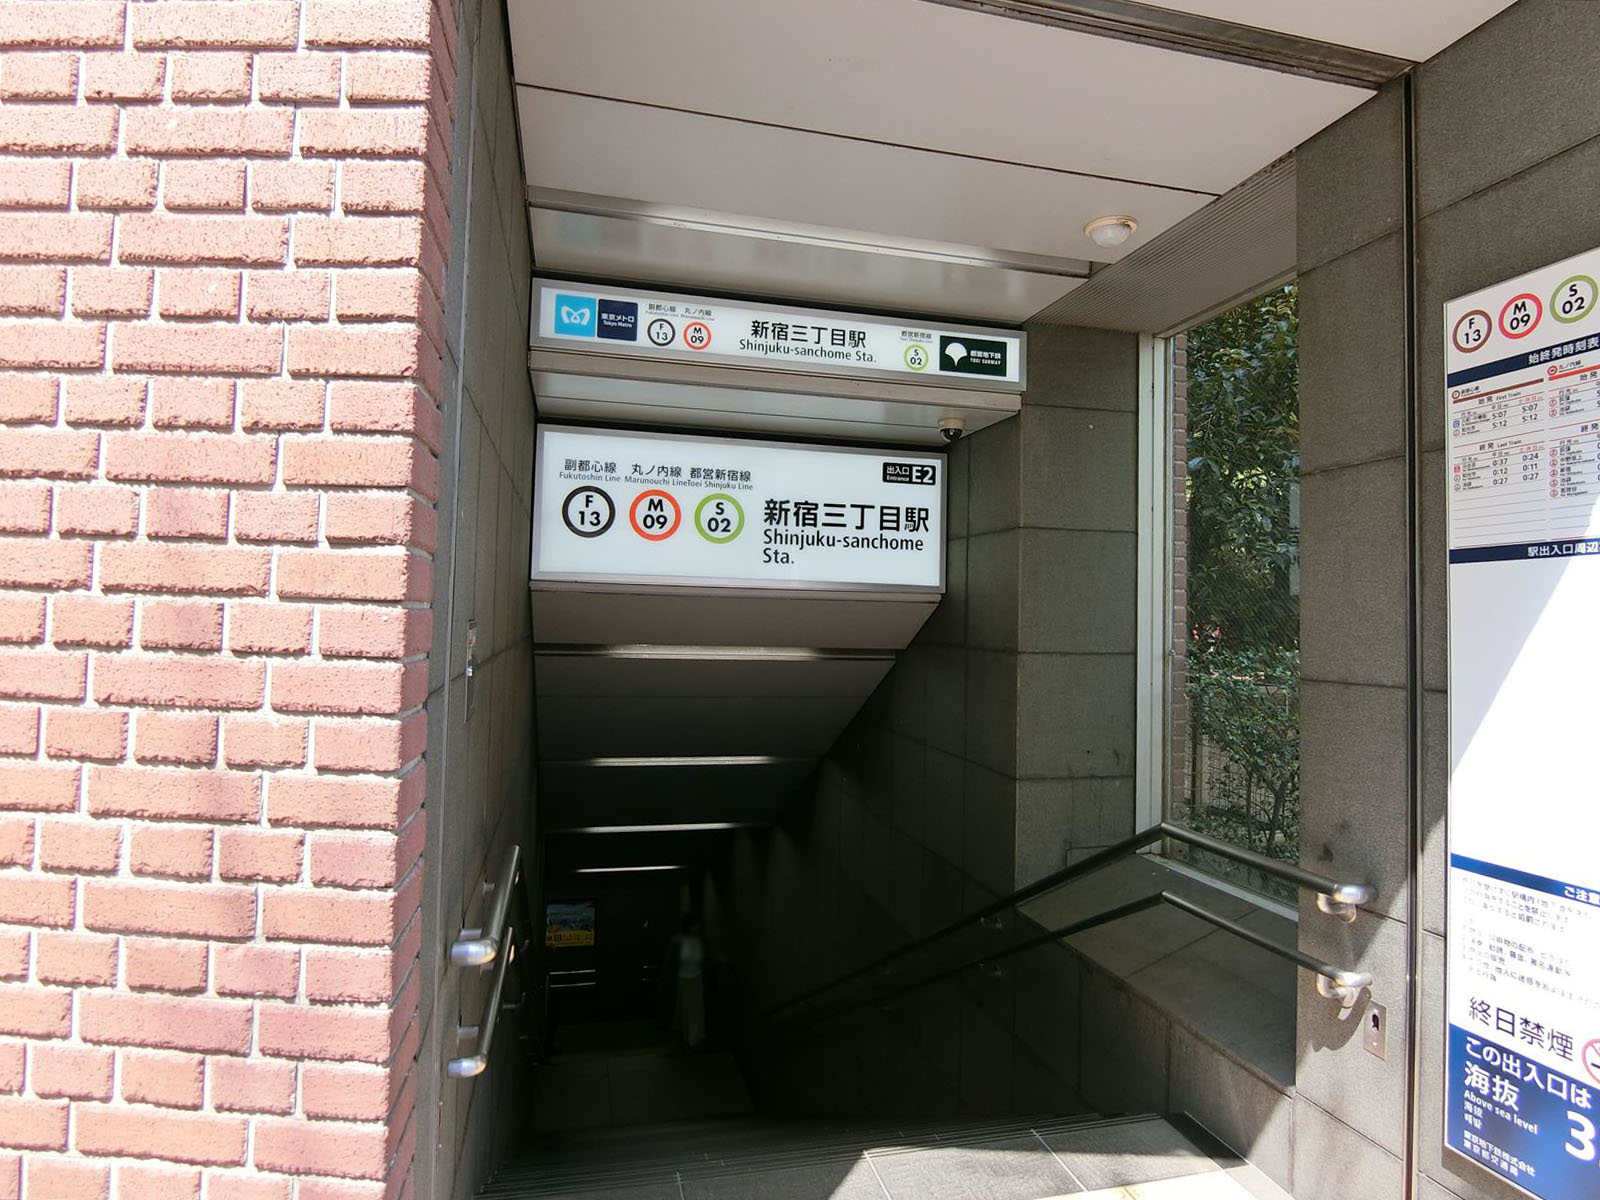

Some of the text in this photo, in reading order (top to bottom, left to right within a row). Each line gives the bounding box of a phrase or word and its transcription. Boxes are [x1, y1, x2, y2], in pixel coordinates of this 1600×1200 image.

[1568, 283, 1578, 297] S
[684, 307, 712, 316] 丸ノ内線
[1513, 300, 1527, 315] M
[1562, 296, 1585, 314] 02
[601, 312, 635, 323] 東京メトロ
[1468, 317, 1475, 330] F
[1510, 313, 1531, 330] 09
[618, 321, 633, 329] Metro
[693, 327, 702, 335] M
[656, 331, 668, 341] 13
[690, 335, 705, 344] 09
[751, 319, 866, 348] 新宿三丁目駅
[1464, 329, 1482, 344] 13
[739, 338, 876, 363] Shinjuku-sanchome Sta.
[914, 348, 919, 357] S
[1528, 336, 1600, 365] 始終発時刻表
[909, 357, 922, 366] 02
[1521, 403, 1538, 413] 5:07
[1492, 411, 1507, 419] 5:07
[1521, 413, 1538, 423] 5:12
[1492, 420, 1507, 429] 5:12
[1492, 458, 1508, 467] 0:37
[1522, 452, 1539, 461] 0:24
[564, 458, 617, 474] 副都心線
[631, 463, 682, 478] 丸ノ内線
[886, 465, 910, 475] 出入口
[1492, 468, 1508, 476] 0:12
[1522, 463, 1538, 471] 0:11
[559, 471, 621, 482] Fukutoshin Line
[624, 475, 688, 487] Marunouchi Line
[690, 467, 751, 482] 都営新宿線
[886, 474, 910, 482] Entrance
[911, 466, 934, 483] E2
[1522, 472, 1539, 481] 0:27
[687, 479, 754, 491] Toei Shinjuku Line
[1492, 477, 1508, 486] 0:27
[585, 495, 594, 508] F
[648, 498, 664, 512] M
[715, 501, 725, 515] S
[578, 511, 601, 526] 13
[642, 514, 668, 529] 09
[763, 498, 930, 533] 新宿三丁目駅
[707, 517, 731, 533] 02
[763, 528, 924, 551] Shinjuku-sanchome
[763, 547, 795, 564] Sta.
[1527, 541, 1600, 557] 駅出入口周辺
[1469, 996, 1574, 1062] 終日禁煙
[1465, 1036, 1592, 1109] この出入口は
[1464, 1060, 1520, 1112] 海抜
[1463, 1089, 1538, 1135] Above sea level
